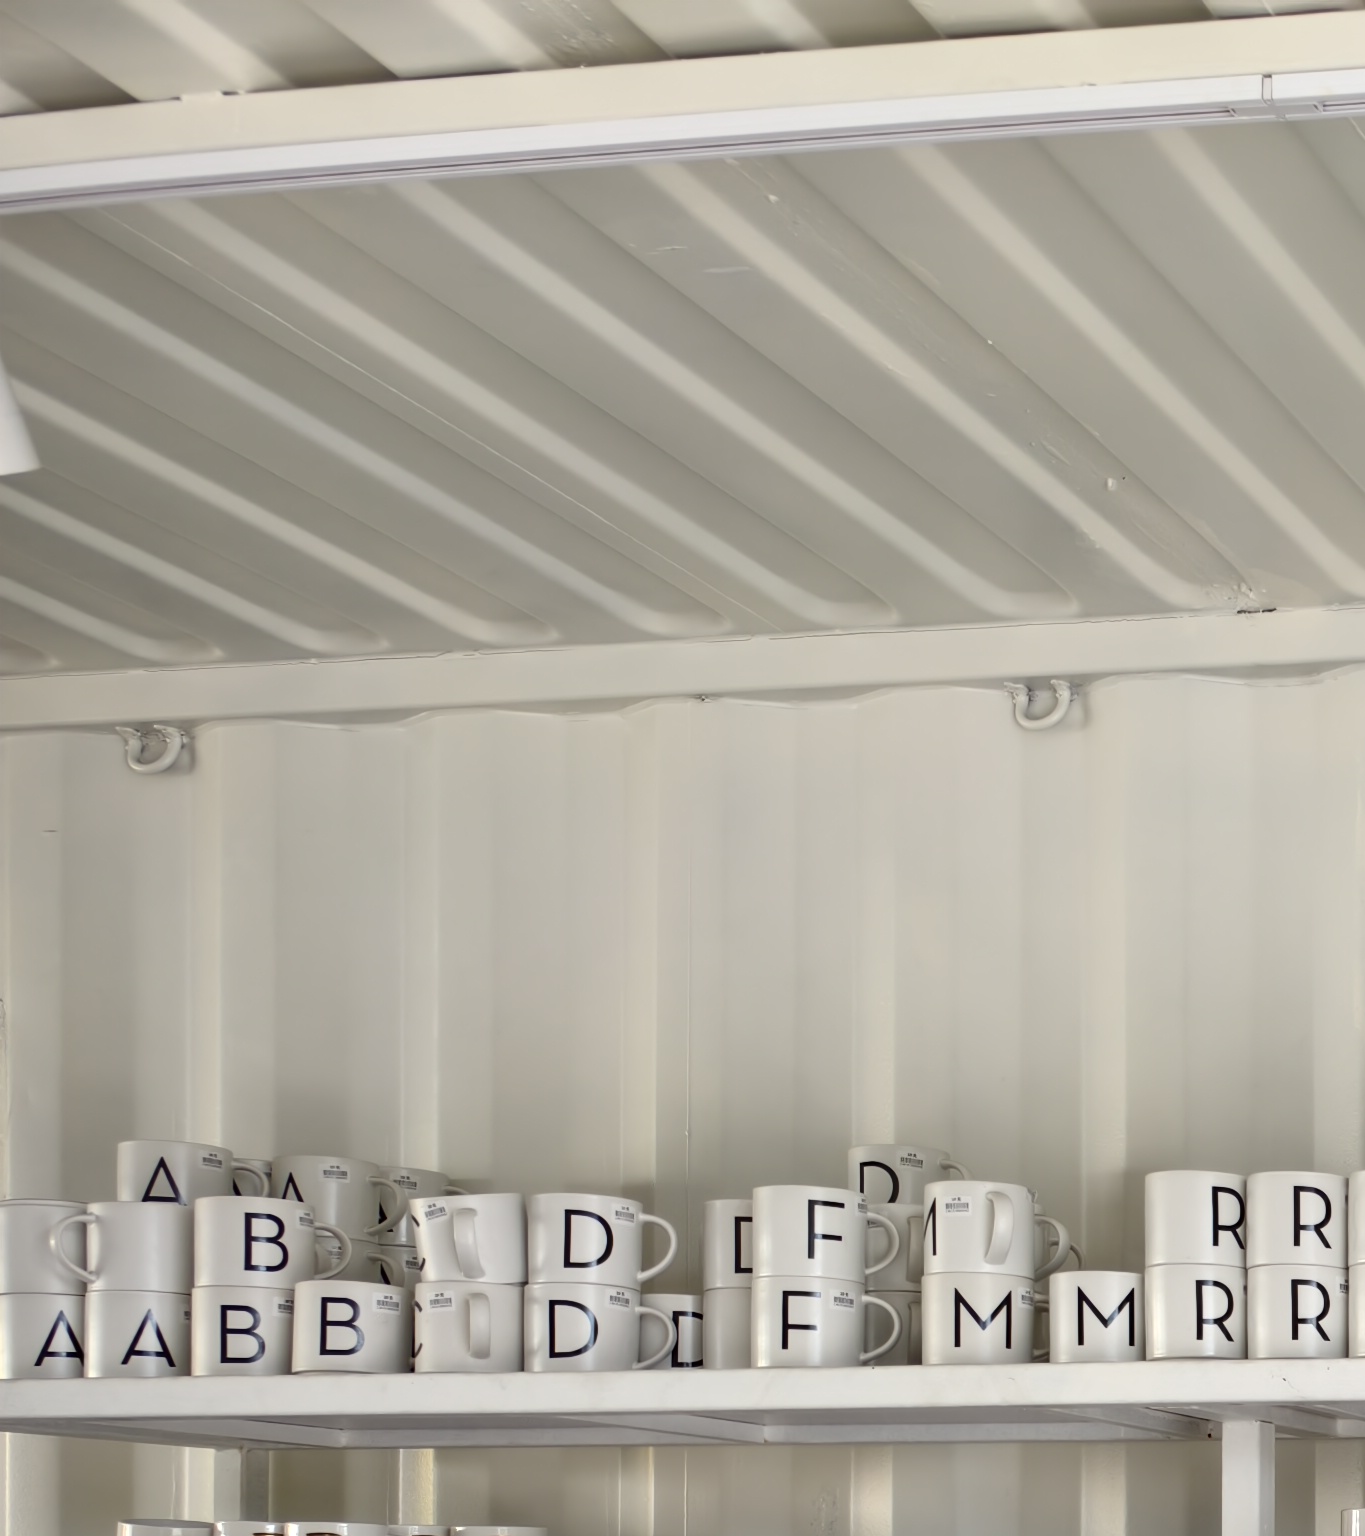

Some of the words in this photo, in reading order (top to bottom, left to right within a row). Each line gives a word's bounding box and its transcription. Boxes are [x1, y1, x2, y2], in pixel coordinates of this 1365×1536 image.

[244, 1213, 288, 1272] B
[564, 1209, 612, 1268] D
[808, 1200, 845, 1259] F
[1293, 1186, 1331, 1249] R
[34, 1311, 84, 1366] A
[121, 1308, 176, 1367] A
[219, 1305, 265, 1363] B
[320, 1297, 364, 1355] B
[549, 1300, 598, 1358] D
[782, 1291, 821, 1349] F
[954, 1289, 1011, 1349] M
[1078, 1288, 1135, 1346] M
[1196, 1280, 1234, 1342] R
